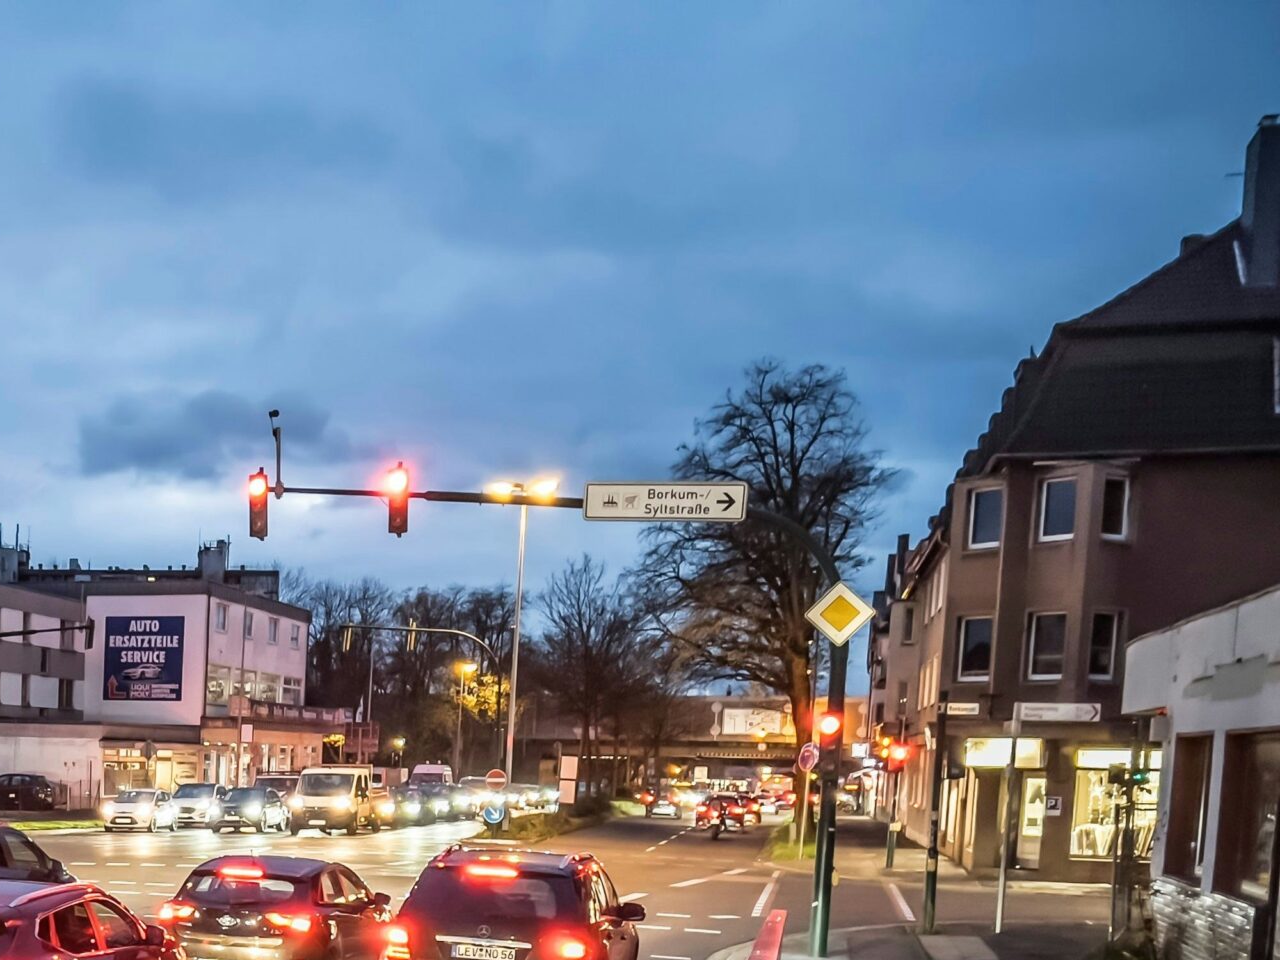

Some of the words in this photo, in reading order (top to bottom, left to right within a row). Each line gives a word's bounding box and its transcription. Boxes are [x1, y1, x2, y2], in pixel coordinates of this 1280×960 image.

[647, 488, 712, 500] Borkum-/
[644, 503, 710, 518] Syltstraße
[129, 620, 160, 632] AUTO
[109, 635, 179, 648] ERSATZTEILE
[120, 650, 166, 663] SERVICE
[130, 683, 151, 691] LIQUI
[130, 691, 151, 699] MOLY
[458, 947, 479, 957] LEV
[500, 950, 514, 960] 56
